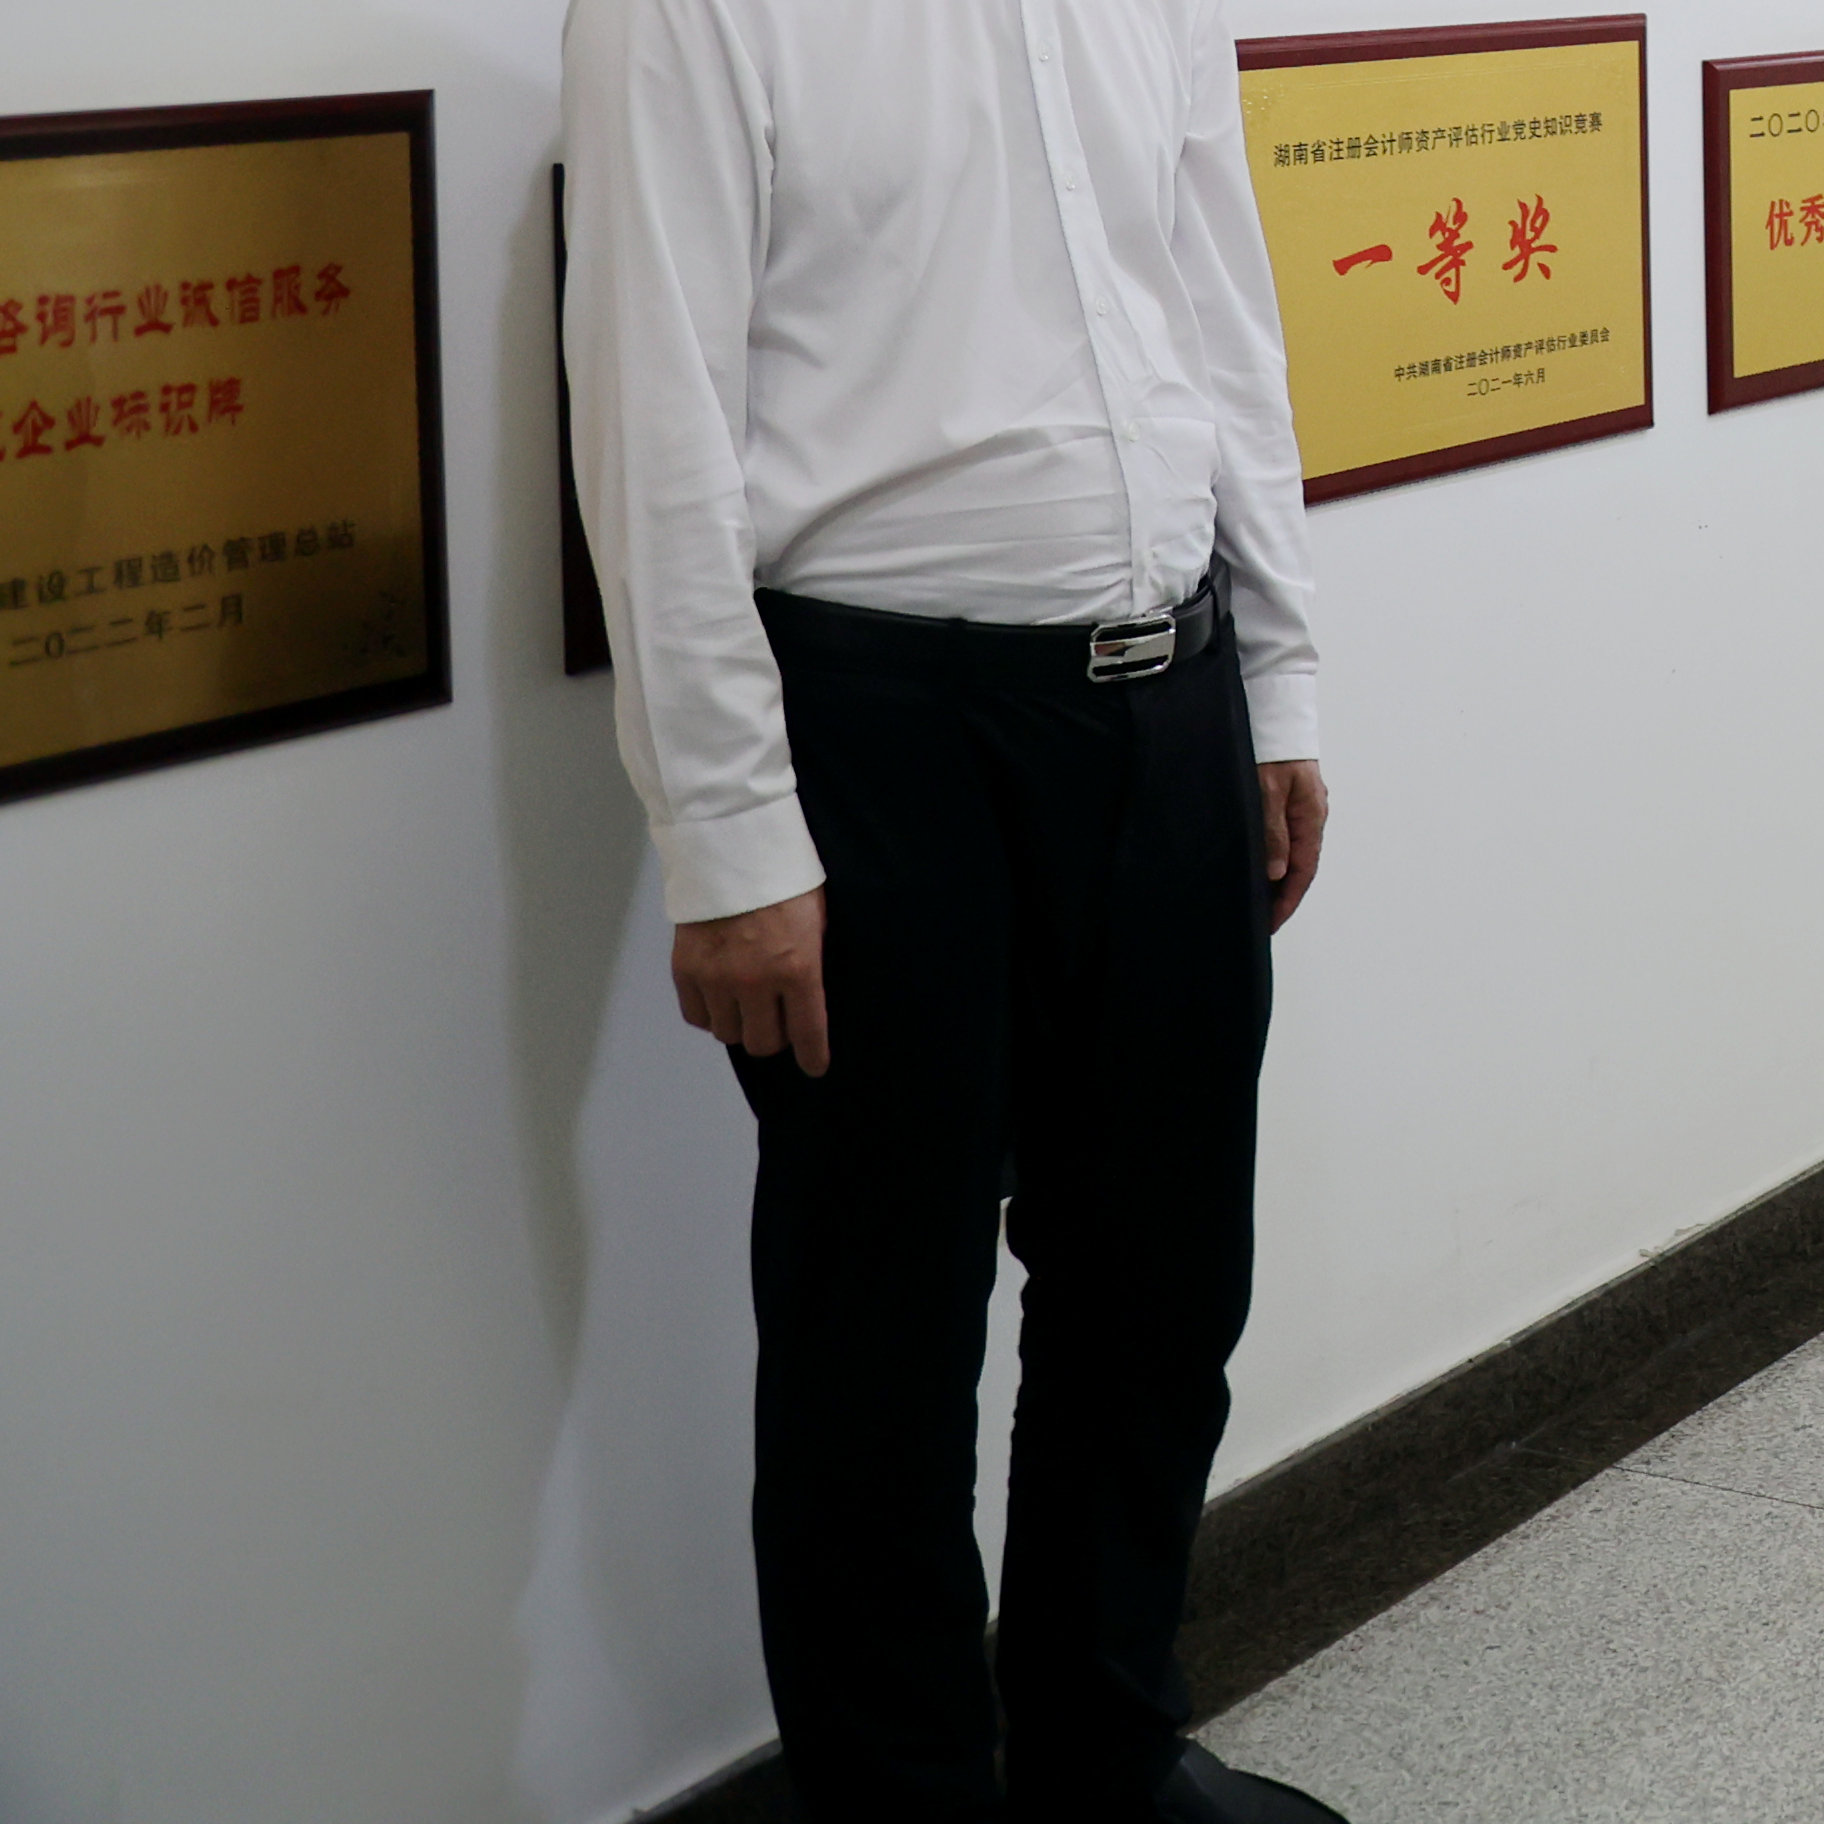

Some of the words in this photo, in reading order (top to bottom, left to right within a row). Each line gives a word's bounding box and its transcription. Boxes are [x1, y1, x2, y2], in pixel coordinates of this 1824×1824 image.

[1273, 111, 1603, 168] 湖南省注册会计师资产评估行业党史知识竞赛
[1332, 193, 1558, 306] 一等奖
[1466, 367, 1546, 397] 二〇二一年六月
[0, 377, 245, 463] 企业标识牌
